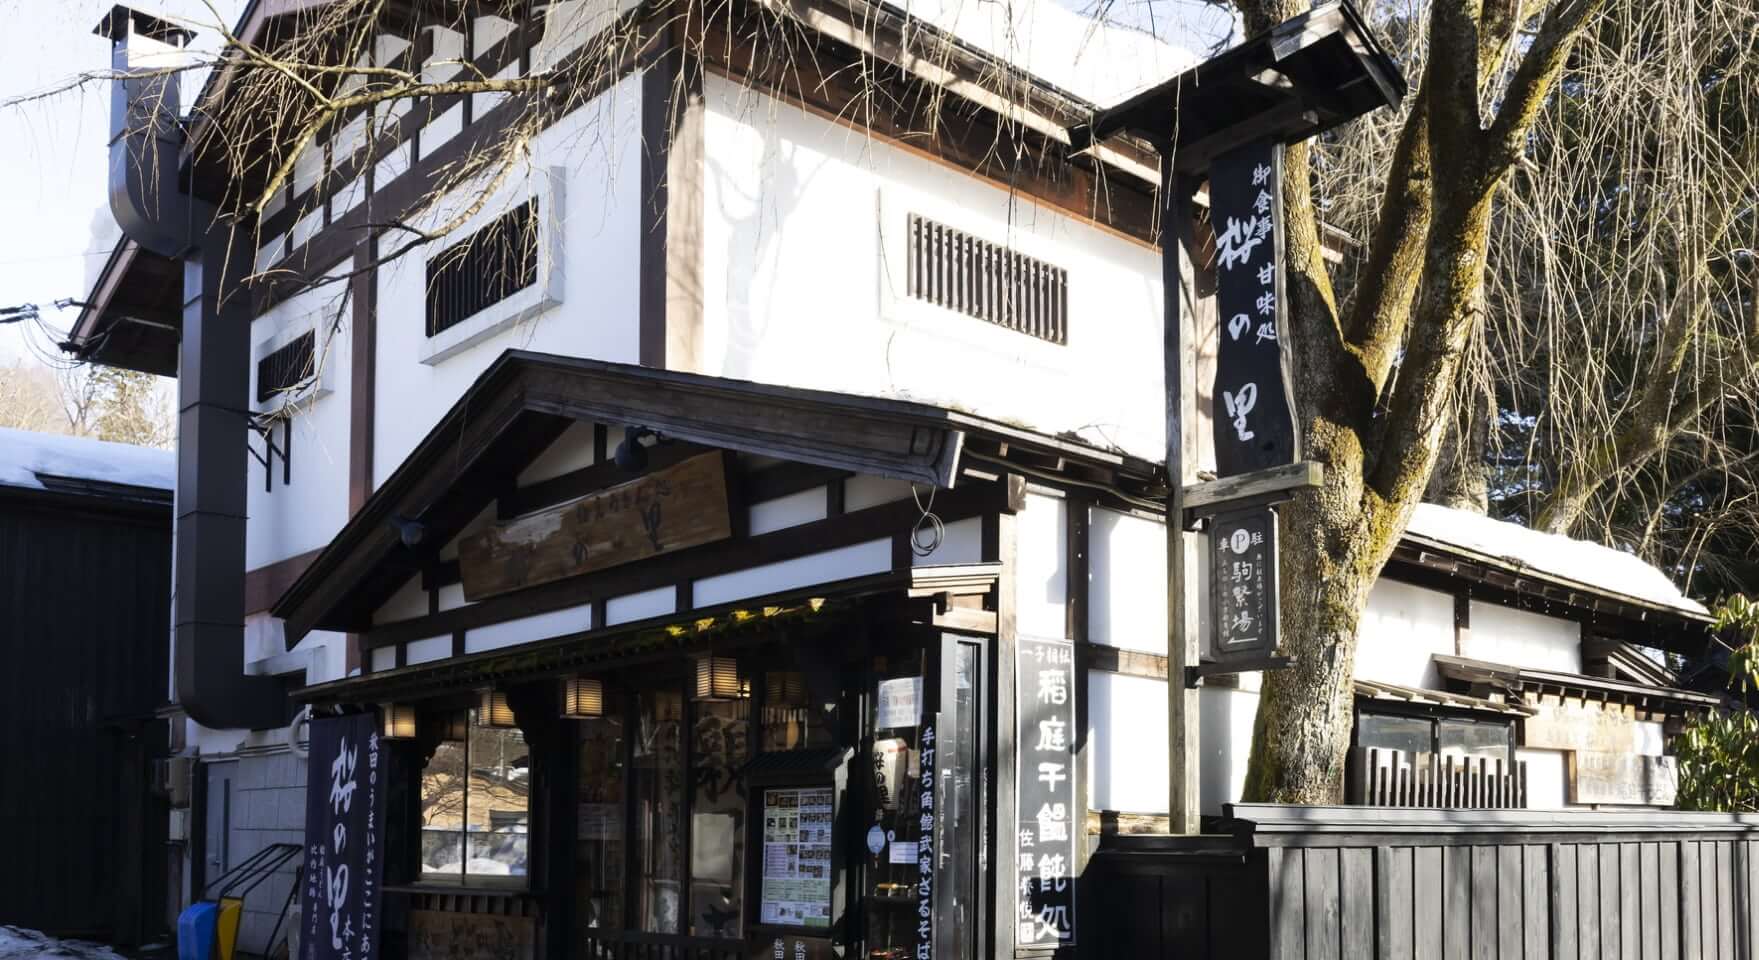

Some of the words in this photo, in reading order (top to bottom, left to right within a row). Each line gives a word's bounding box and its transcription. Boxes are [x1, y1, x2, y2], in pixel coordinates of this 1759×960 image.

[1251, 163, 1273, 241] 御食事
[1216, 215, 1264, 441] 桜の里
[1256, 262, 1277, 345] 甘味処
[1250, 531, 1264, 546] 駐
[327, 736, 358, 950] 桜の里
[360, 732, 379, 960] 秋田のうまいがここにあ
